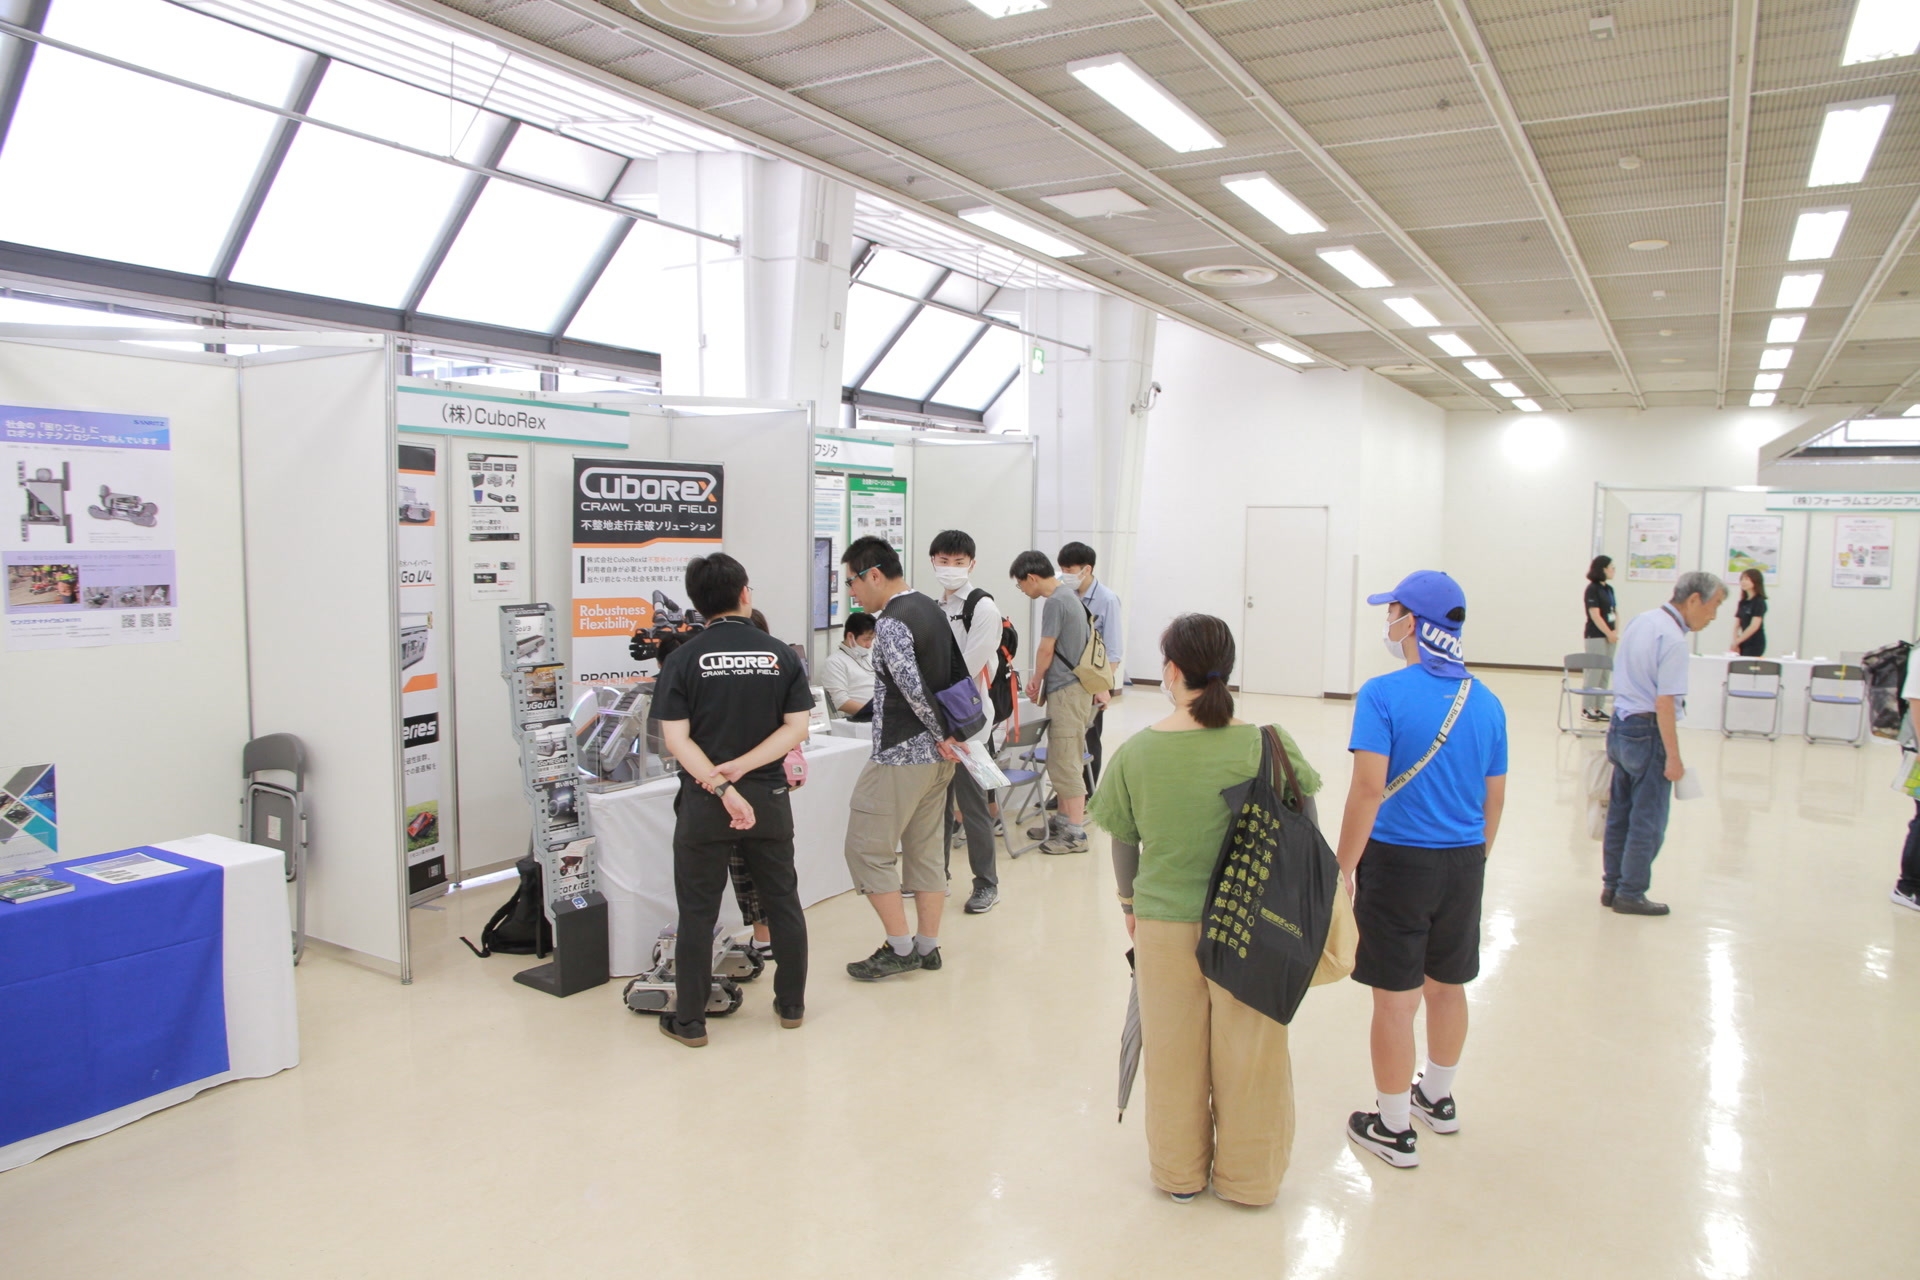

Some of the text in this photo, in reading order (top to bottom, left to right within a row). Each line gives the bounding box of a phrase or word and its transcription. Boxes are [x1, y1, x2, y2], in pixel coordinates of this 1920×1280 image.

[442, 403, 546, 430] (株)CuboRex
[581, 502, 717, 514] CRAWL YOUR FIELD
[581, 520, 715, 531] 不整地走行走破ソリューション
[580, 604, 646, 617] Robustness
[580, 617, 637, 631] Flexibility
[702, 670, 729, 678] CRAWL
